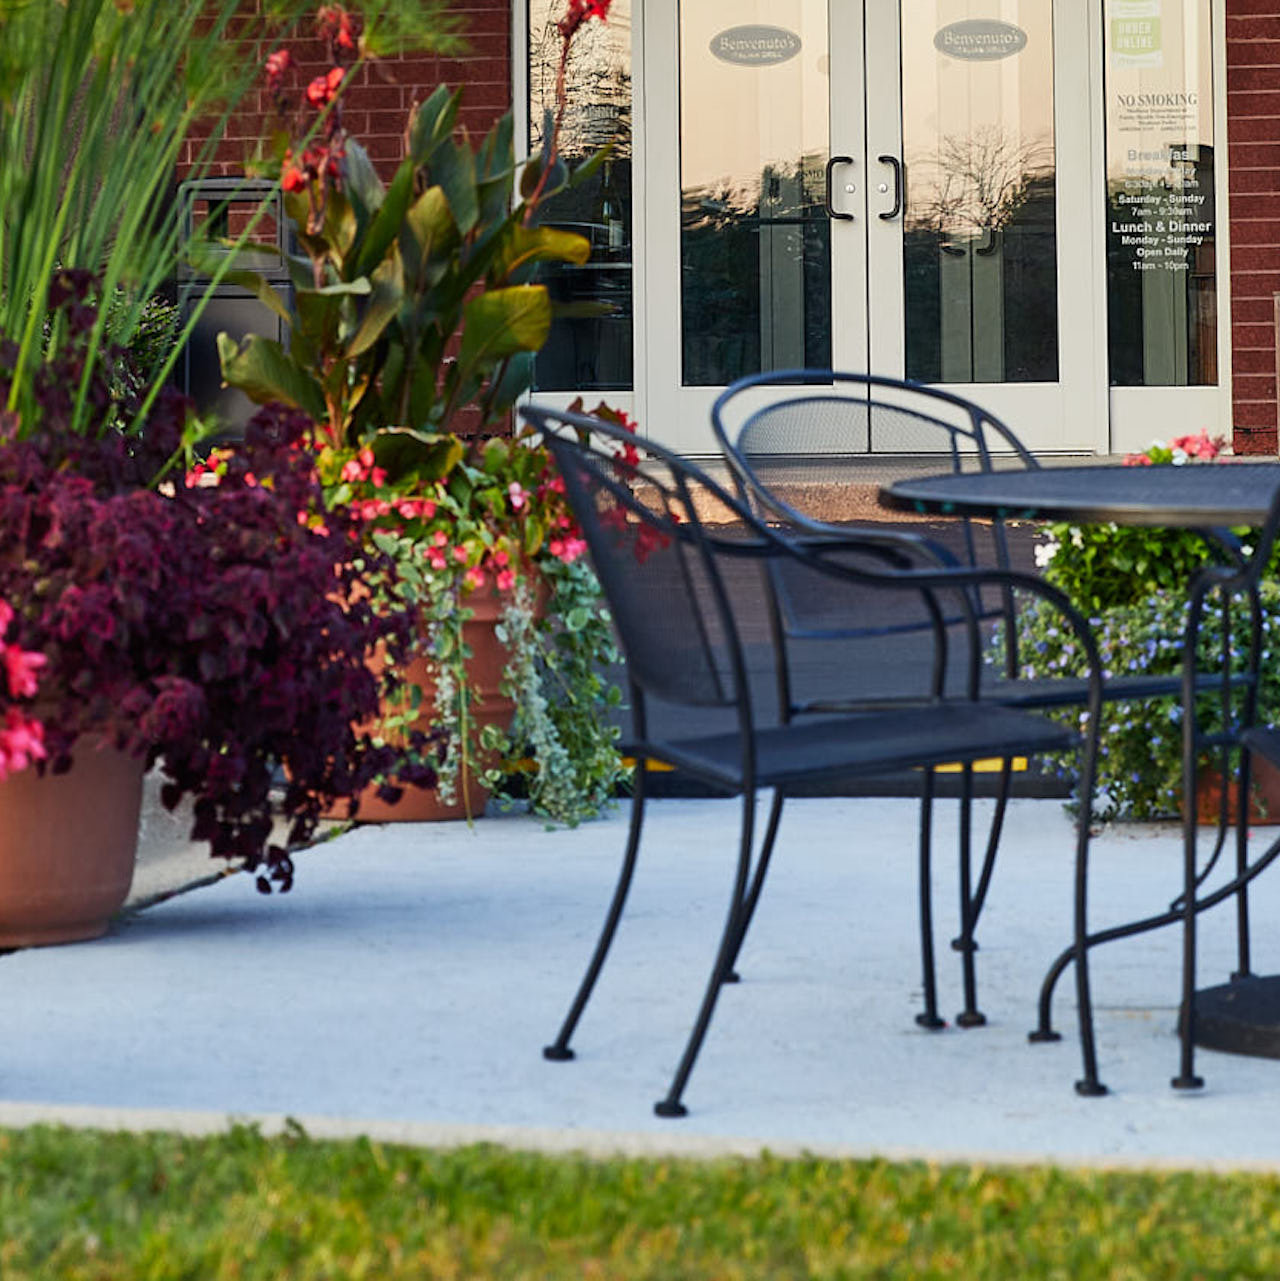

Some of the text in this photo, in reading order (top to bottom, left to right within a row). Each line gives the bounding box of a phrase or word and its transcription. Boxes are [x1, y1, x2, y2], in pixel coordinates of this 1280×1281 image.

[720, 33, 795, 51] Benvenuto's
[943, 29, 1019, 46] Benvenuto's
[1117, 93, 1198, 107] NO SMOKING
[1118, 194, 1161, 205] Saturday
[1169, 194, 1205, 205] Sunday
[1112, 220, 1212, 233] Lunch & Dinner
[1121, 235, 1160, 246] Monday
[1166, 234, 1204, 245] Sunday
[1136, 247, 1190, 259] Open Daily
[1132, 261, 1156, 270] 11am
[1164, 260, 1190, 272] 10pm
